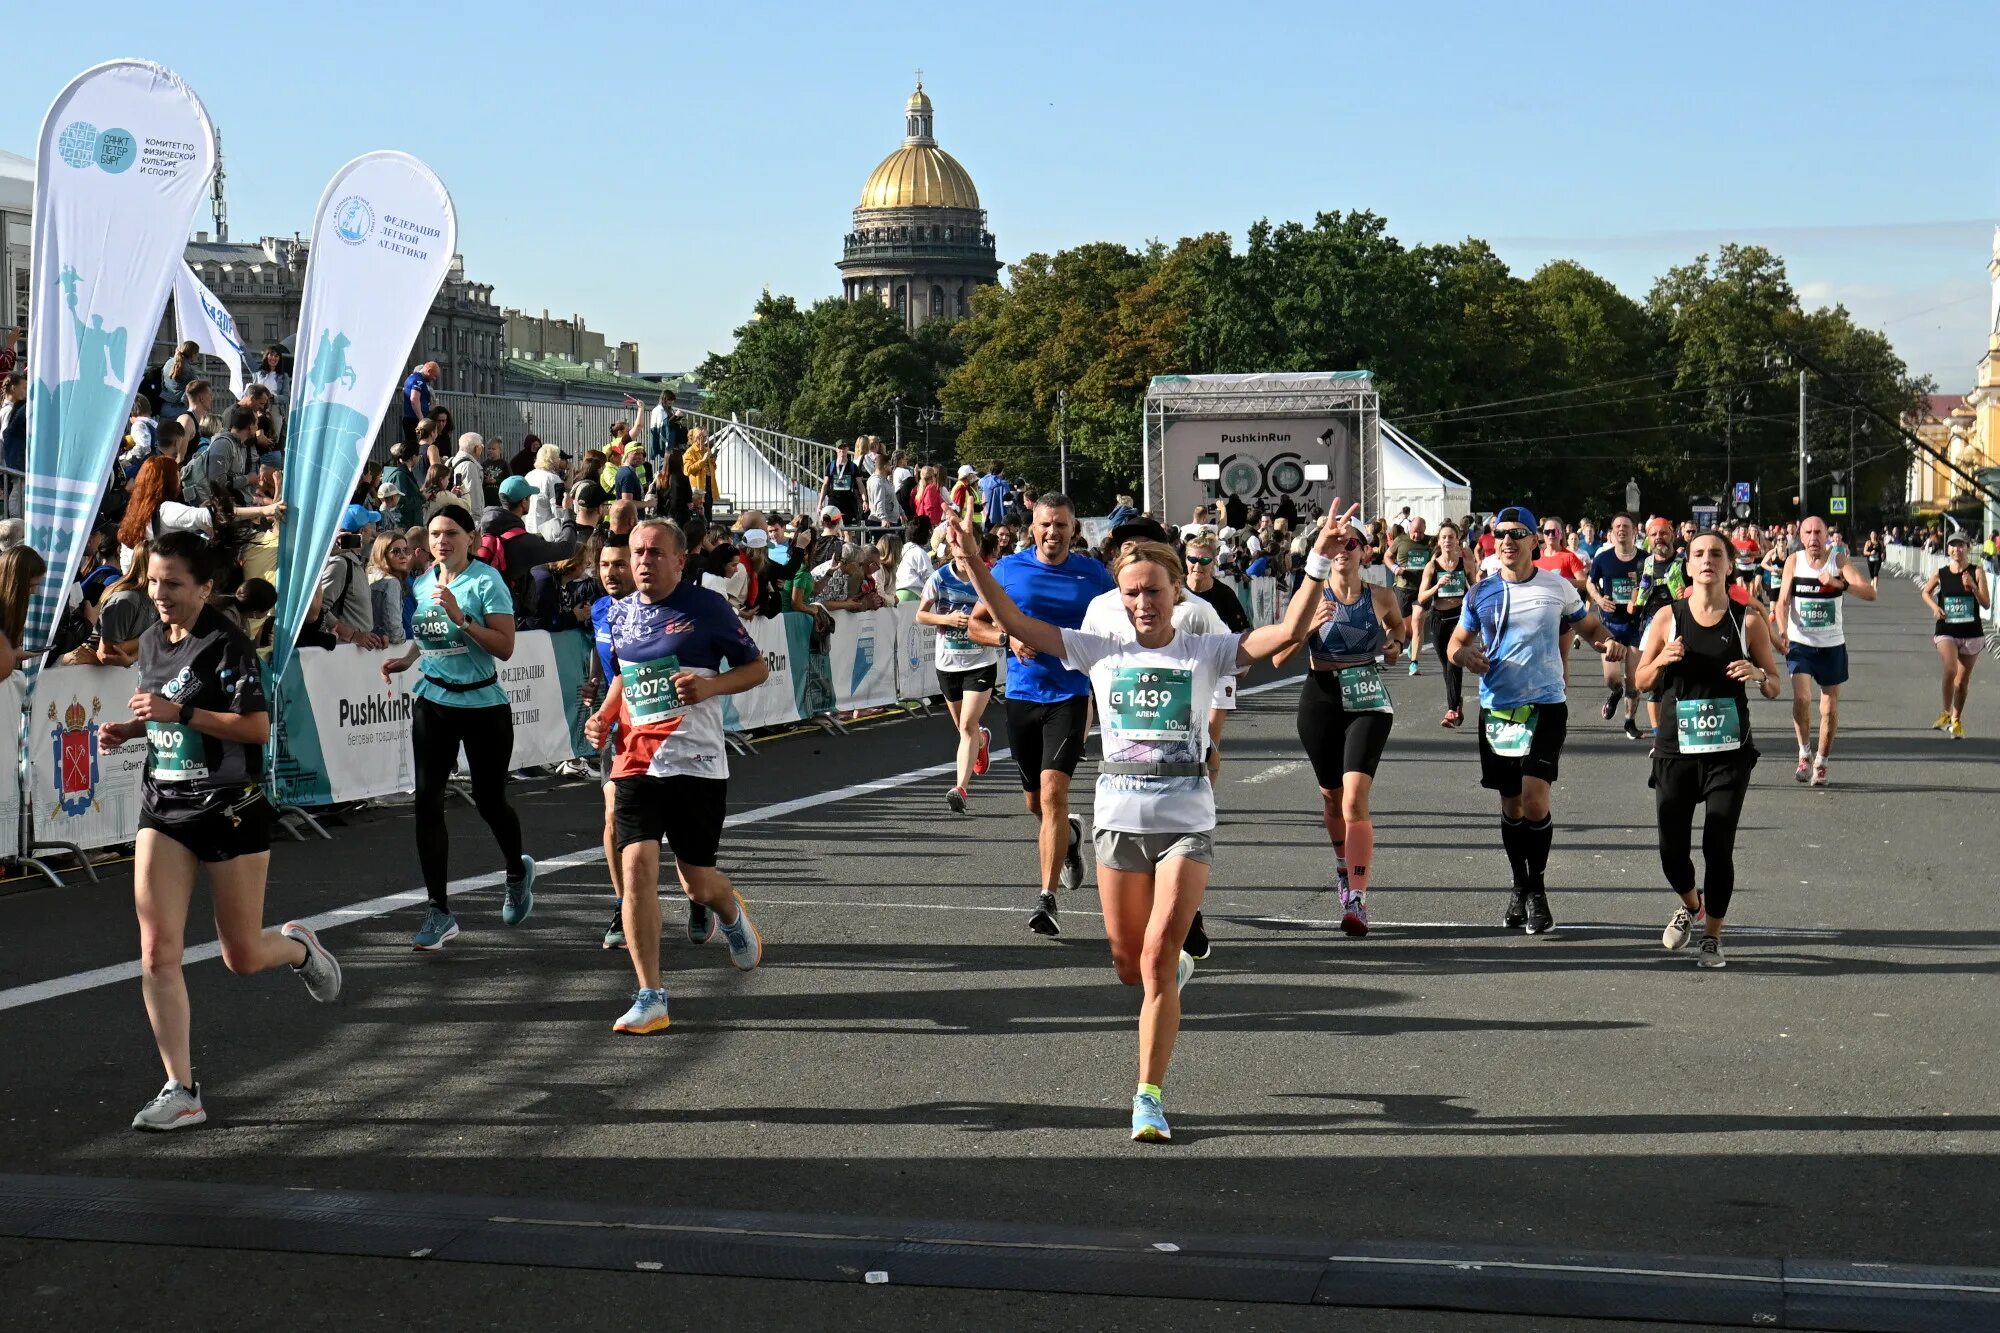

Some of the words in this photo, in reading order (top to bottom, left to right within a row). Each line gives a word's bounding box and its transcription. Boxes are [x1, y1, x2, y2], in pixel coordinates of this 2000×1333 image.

[104, 135, 130, 146] САНКТ
[145, 138, 181, 149] КОМИТЕТ
[182, 143, 195, 151] ПО
[102, 144, 128, 156] ПЕТЕР
[143, 148, 196, 161] ФИЗИЧЕСКОЙ
[100, 155, 121, 166] БУРГ
[142, 157, 178, 168] КУЛЬТУРЕ
[147, 168, 178, 178] СПОРТУ
[384, 215, 441, 238] ФЕДЕРАЦИЯ
[380, 227, 420, 245] ЛЕГКОЙ
[378, 239, 428, 260] АТЛЕТИКИ
[1221, 432, 1291, 443] PushkinRun
[1796, 584, 1820, 593] WORLD
[1807, 610, 1828, 619] 1886
[1951, 604, 1967, 612] 2921
[420, 621, 449, 635] 2483
[952, 631, 969, 640] 266
[763, 651, 786, 671] nRun
[501, 664, 545, 682] ФЕДЕРАЦИЯ
[632, 677, 670, 698] 2073
[1353, 680, 1382, 695] 1864
[506, 685, 531, 704] ЕГКОЙ
[636, 694, 672, 707] КОНСТАНТИН
[1127, 690, 1172, 707] 1439
[339, 690, 416, 727] PushkinR
[1135, 710, 1161, 718] АЛЕНА
[512, 709, 540, 725] ЛЕТИКИ
[1690, 714, 1725, 729] 1607
